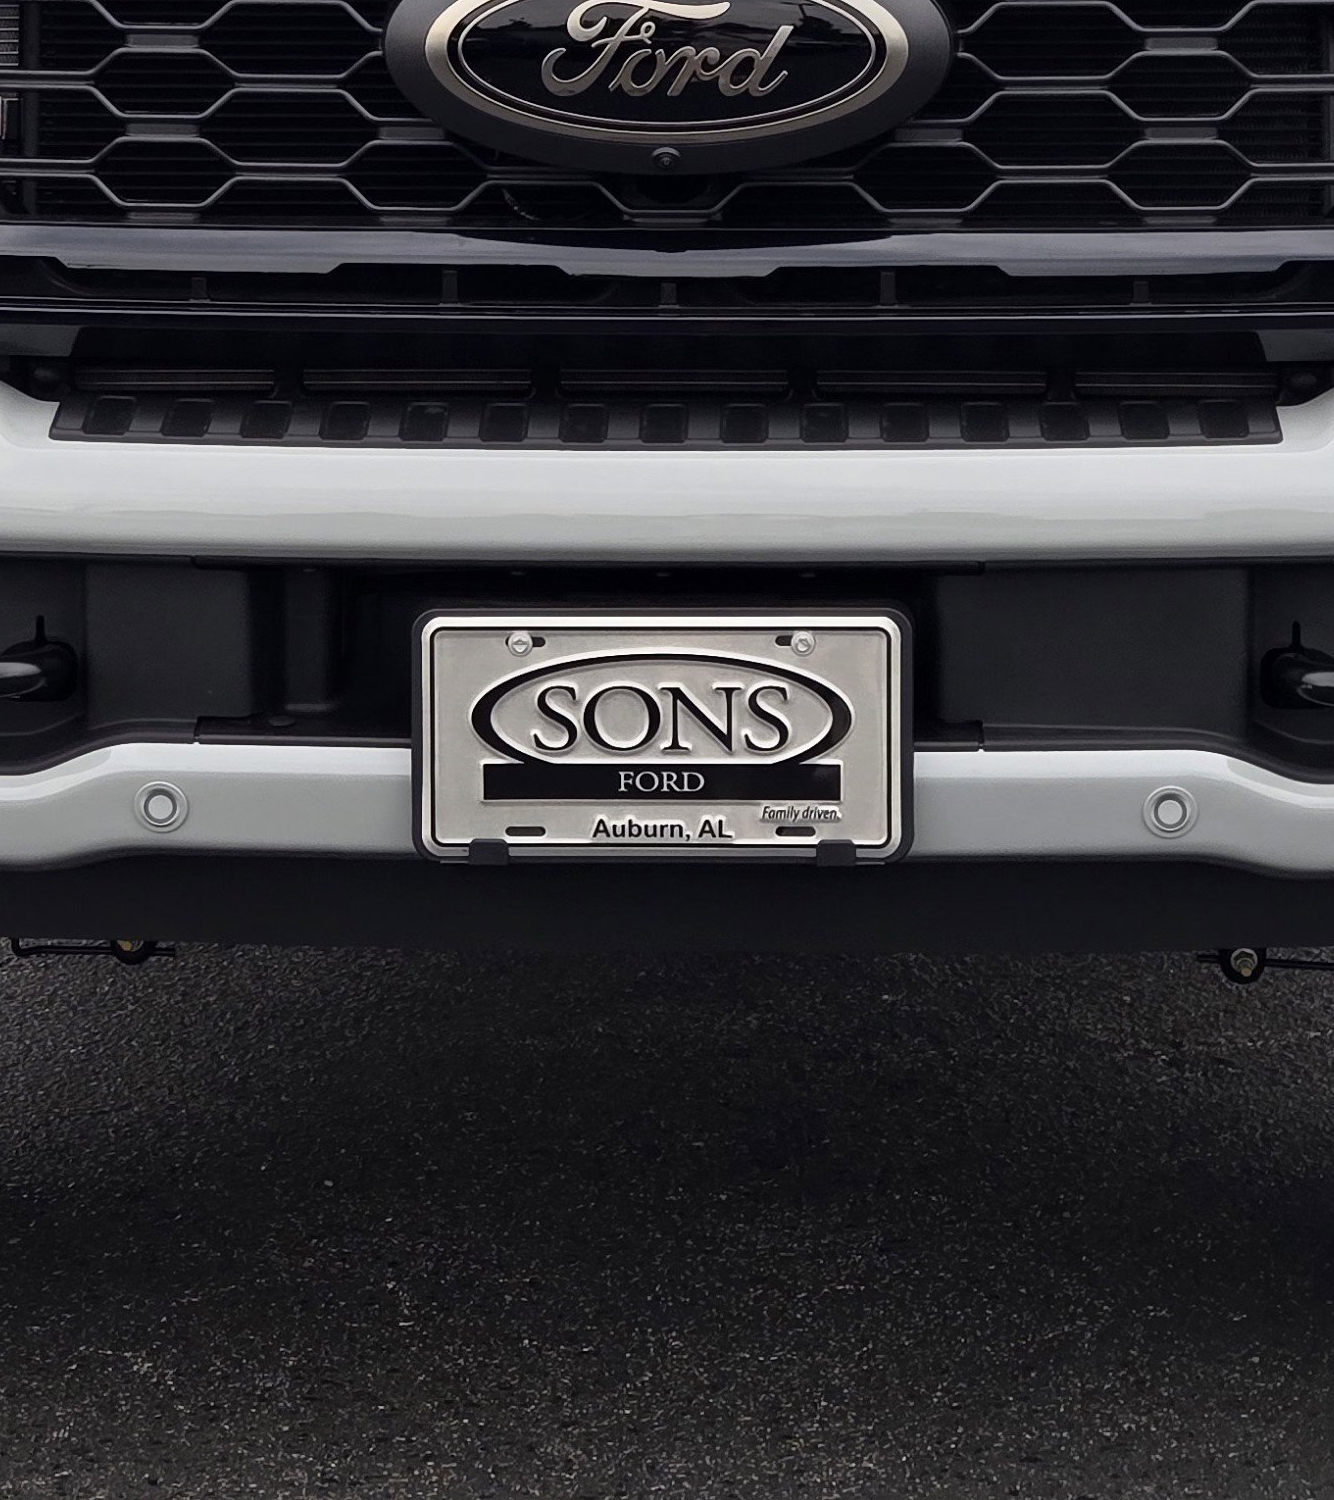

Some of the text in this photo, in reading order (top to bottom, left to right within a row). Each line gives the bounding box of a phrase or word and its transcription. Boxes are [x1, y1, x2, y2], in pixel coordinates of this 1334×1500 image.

[531, 684, 790, 752] SONS
[617, 771, 705, 793] FORD
[761, 806, 842, 821] Family driven.
[591, 818, 733, 841] Auburn, AL
